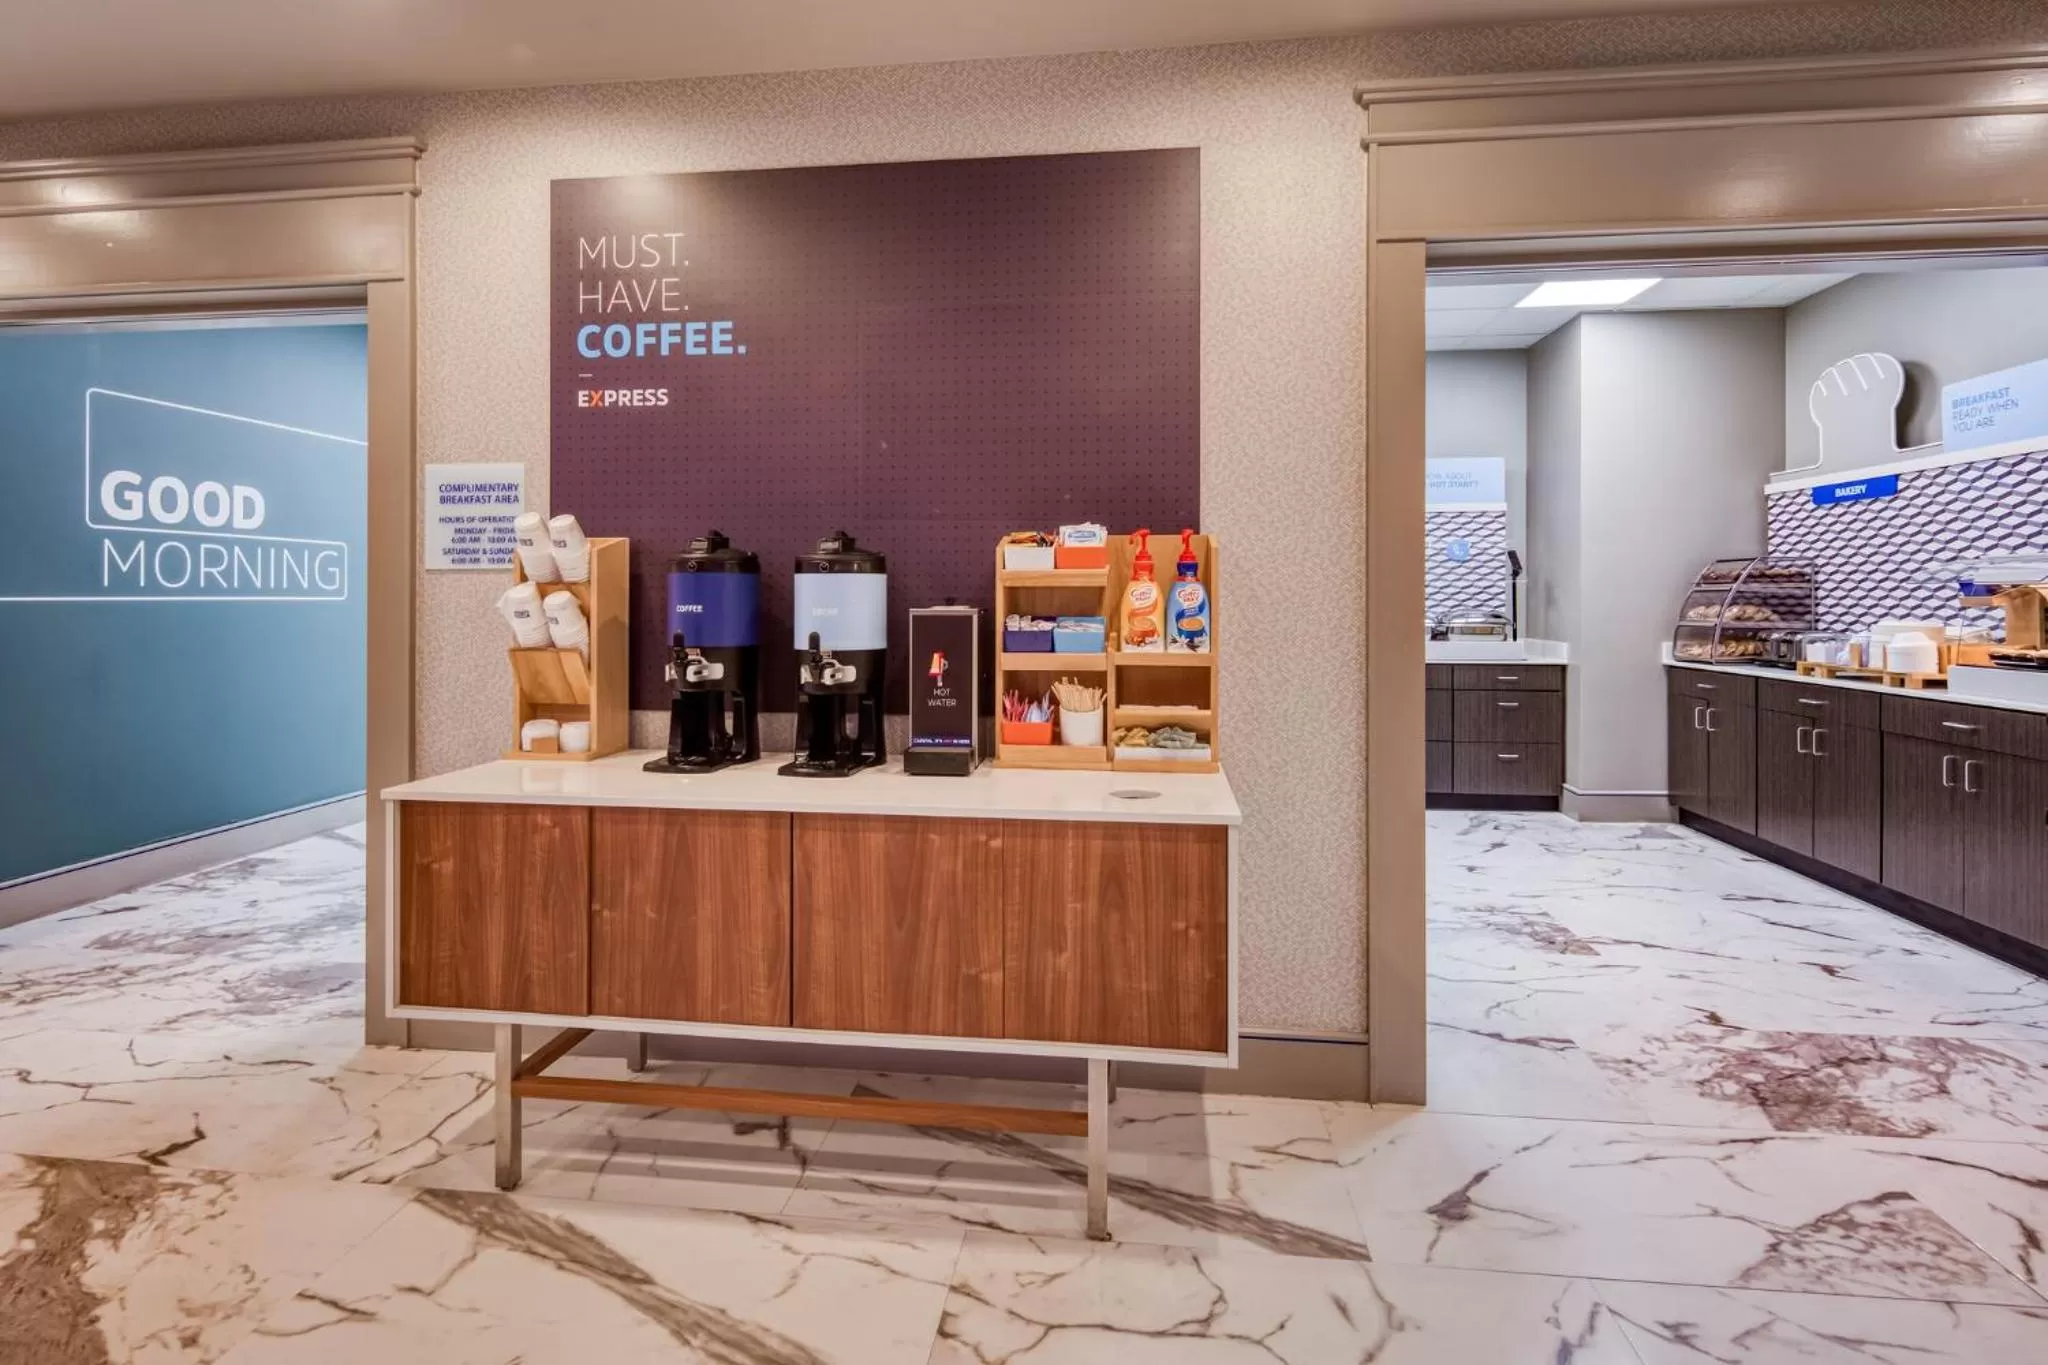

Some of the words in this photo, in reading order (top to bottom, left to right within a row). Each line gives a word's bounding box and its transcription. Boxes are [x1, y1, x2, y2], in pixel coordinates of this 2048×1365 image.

[579, 233, 689, 270] MUST.
[579, 278, 689, 314] HAVE.
[577, 321, 747, 359] COFFEE.
[578, 389, 669, 408] EXPRESS
[1952, 387, 2011, 408] BREAKFAST
[1987, 398, 2019, 414] WHEN
[1952, 406, 1983, 422] READY
[1952, 419, 1973, 432] YOU
[1975, 416, 1996, 428] ARE
[439, 483, 520, 493] COMPLIMENTARY
[1834, 484, 1867, 498] BAKERY
[100, 470, 266, 529] GOOD
[439, 495, 492, 505] BREAKFAST
[495, 494, 520, 504] AREA
[439, 516, 465, 524] HOURS
[103, 538, 340, 590] MORNING
[676, 604, 703, 612] COFFEE
[933, 688, 951, 697] HOT
[927, 699, 957, 707] WATER
